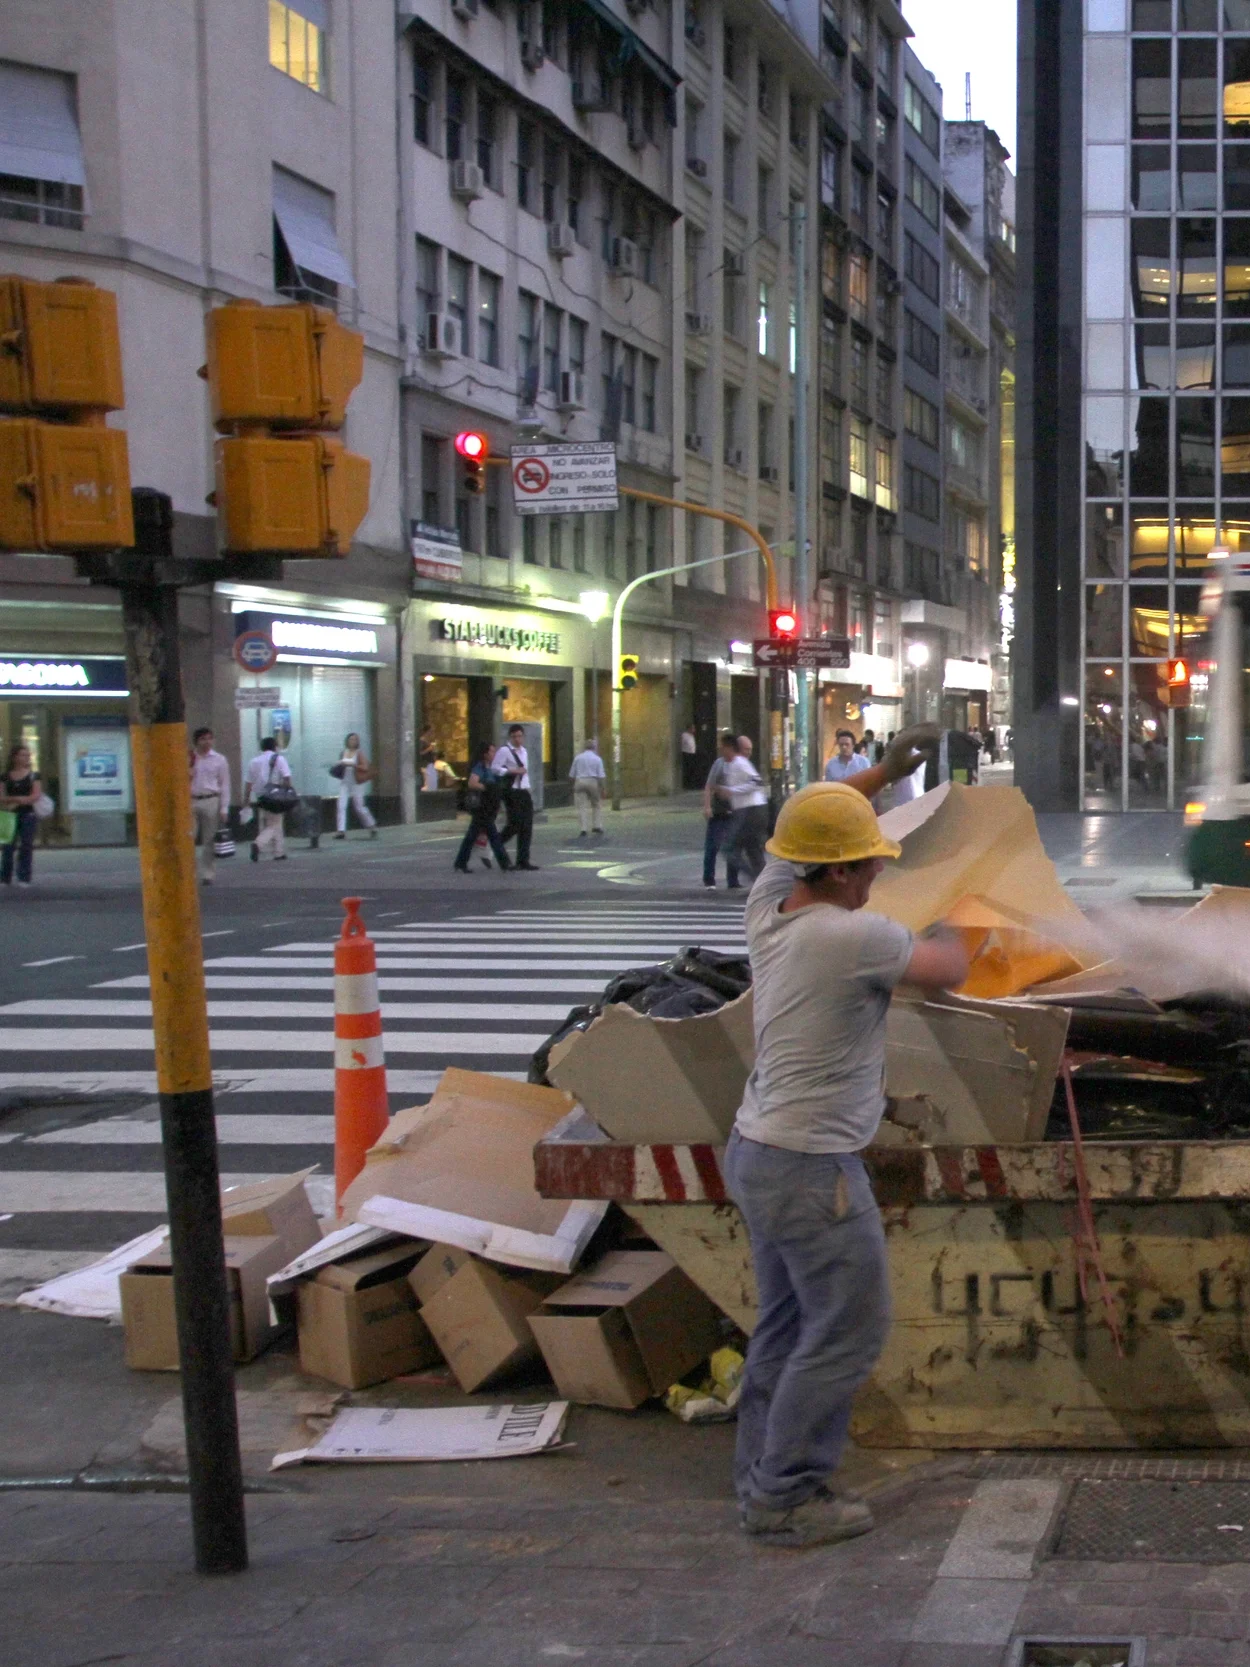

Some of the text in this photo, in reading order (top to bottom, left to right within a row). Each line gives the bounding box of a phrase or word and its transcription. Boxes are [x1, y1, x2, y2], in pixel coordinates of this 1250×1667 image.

[552, 456, 610, 467] NO AVANZAR
[592, 469, 616, 479] SOLO
[548, 486, 568, 495] CON
[443, 618, 560, 653] STARBUCKS COFFEE
[798, 640, 831, 649] Avenida
[797, 649, 843, 658] Corrientes
[797, 658, 849, 667] 400 500
[0, 662, 90, 686] AGONIA
